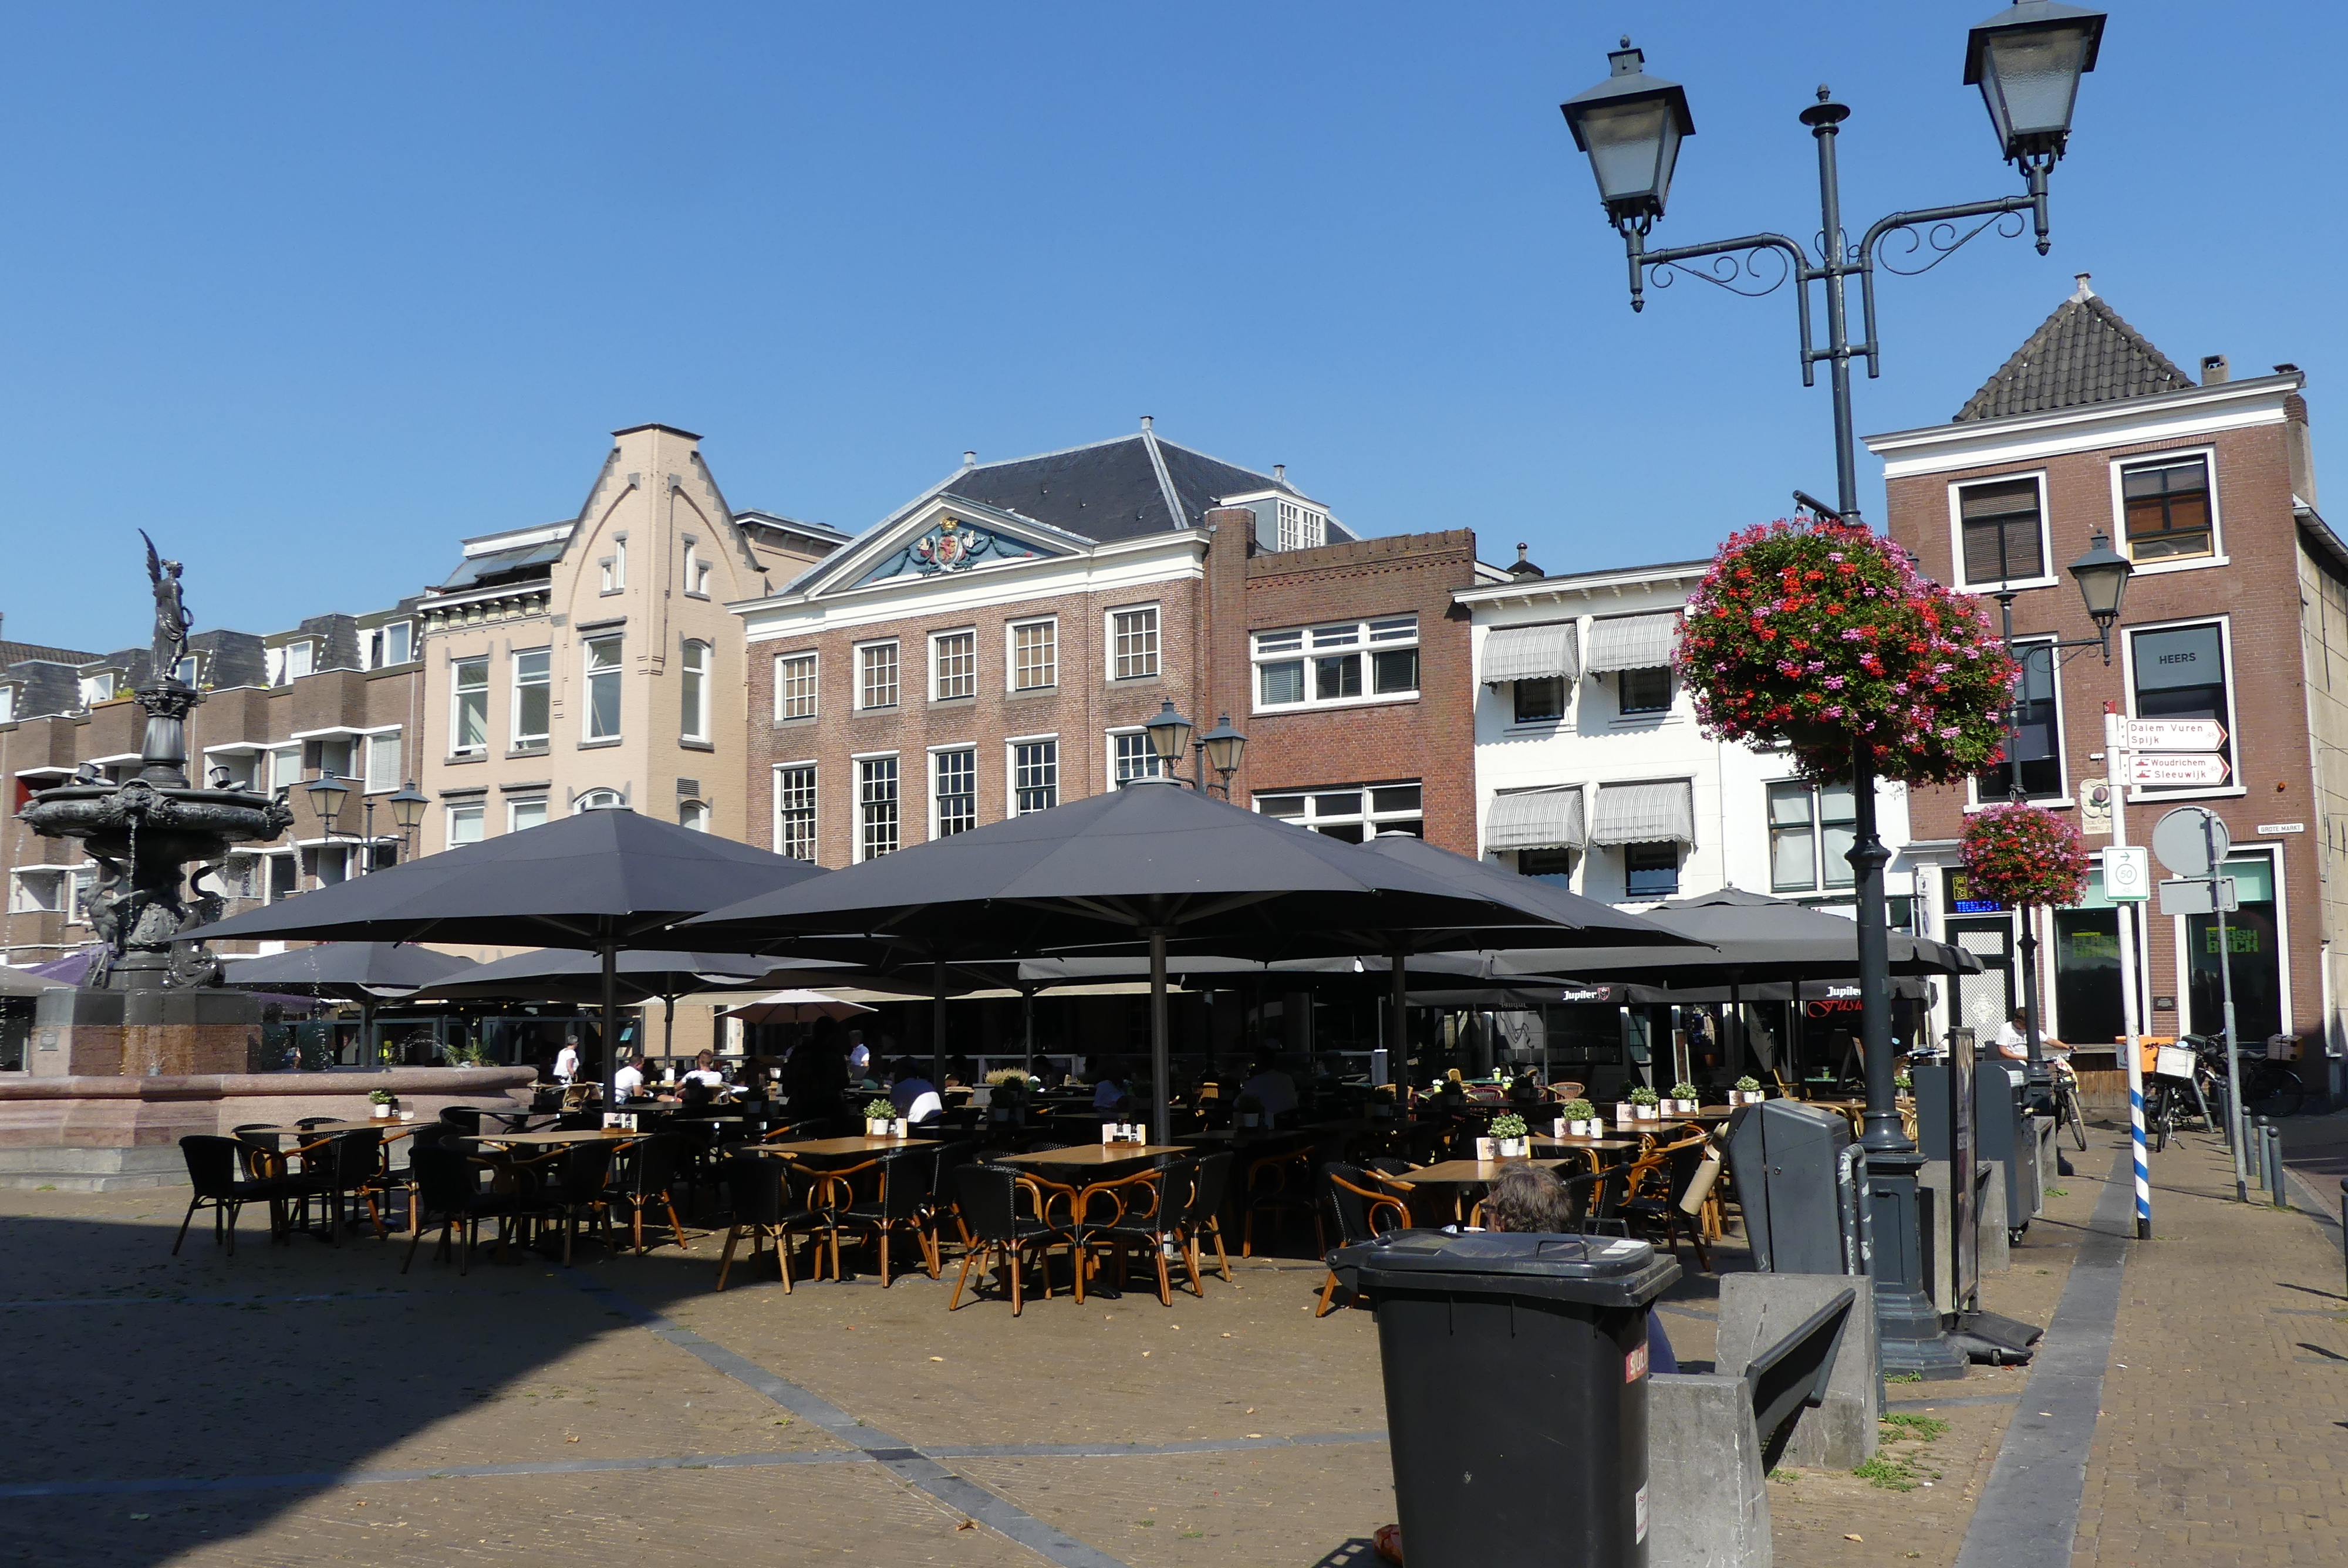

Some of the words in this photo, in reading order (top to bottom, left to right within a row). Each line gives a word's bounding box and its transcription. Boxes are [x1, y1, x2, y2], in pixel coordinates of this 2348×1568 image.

[2160, 653, 2196, 664] HEERS
[2131, 724, 2164, 732] Dalem
[2170, 724, 2203, 732] Vuren
[2131, 736, 2160, 745] Spijk
[2154, 771, 2206, 780] Sleeuwijk
[2120, 870, 2133, 878] 50
[1563, 989, 1597, 1001] Jupiler
